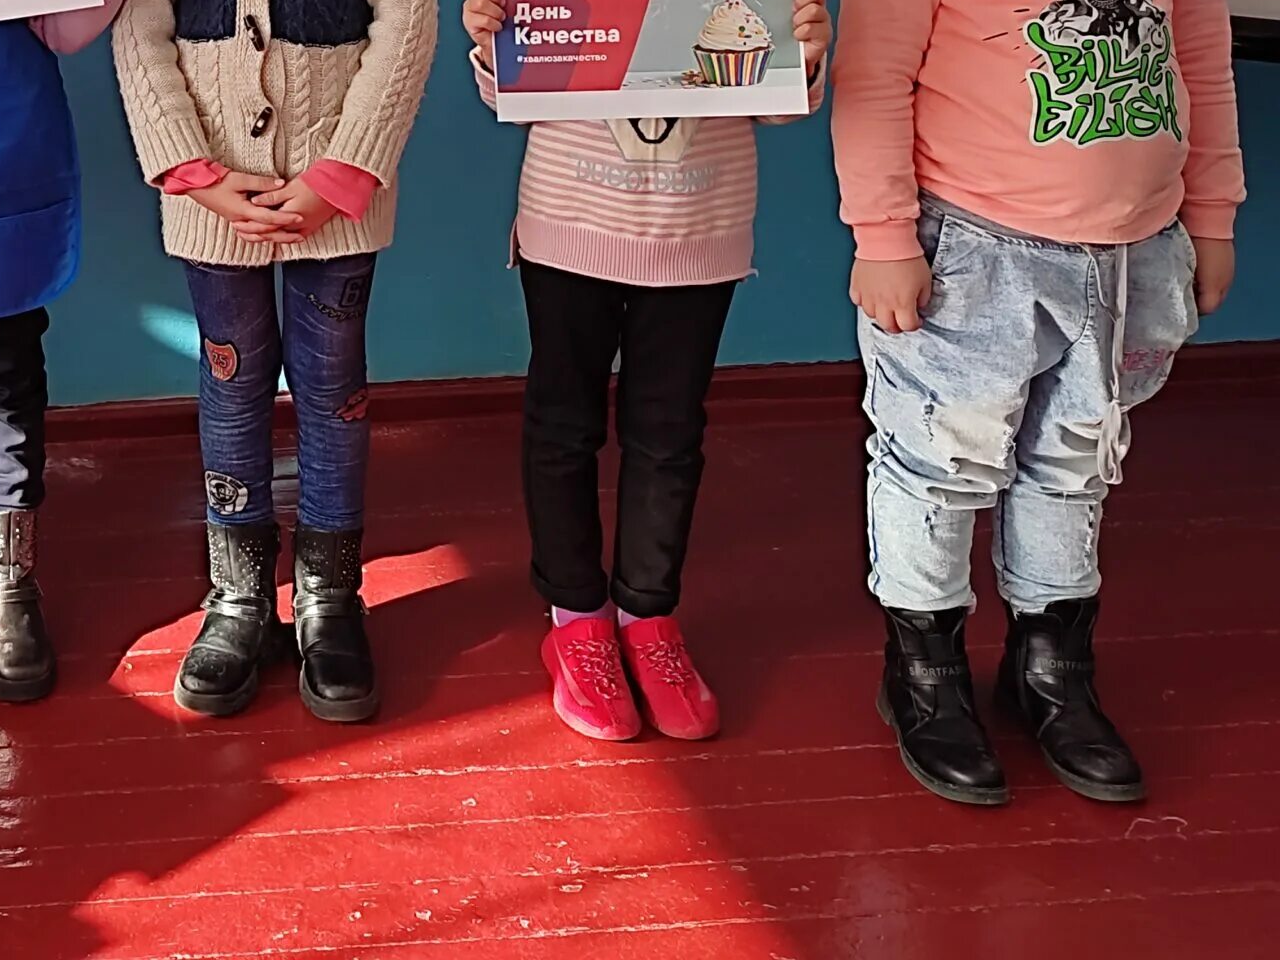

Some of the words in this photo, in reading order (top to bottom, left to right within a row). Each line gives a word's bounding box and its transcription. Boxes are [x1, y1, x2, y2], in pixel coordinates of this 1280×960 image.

[513, 3, 572, 25] День
[514, 26, 620, 46] Качества
[517, 53, 607, 64] #хвалюзакачество
